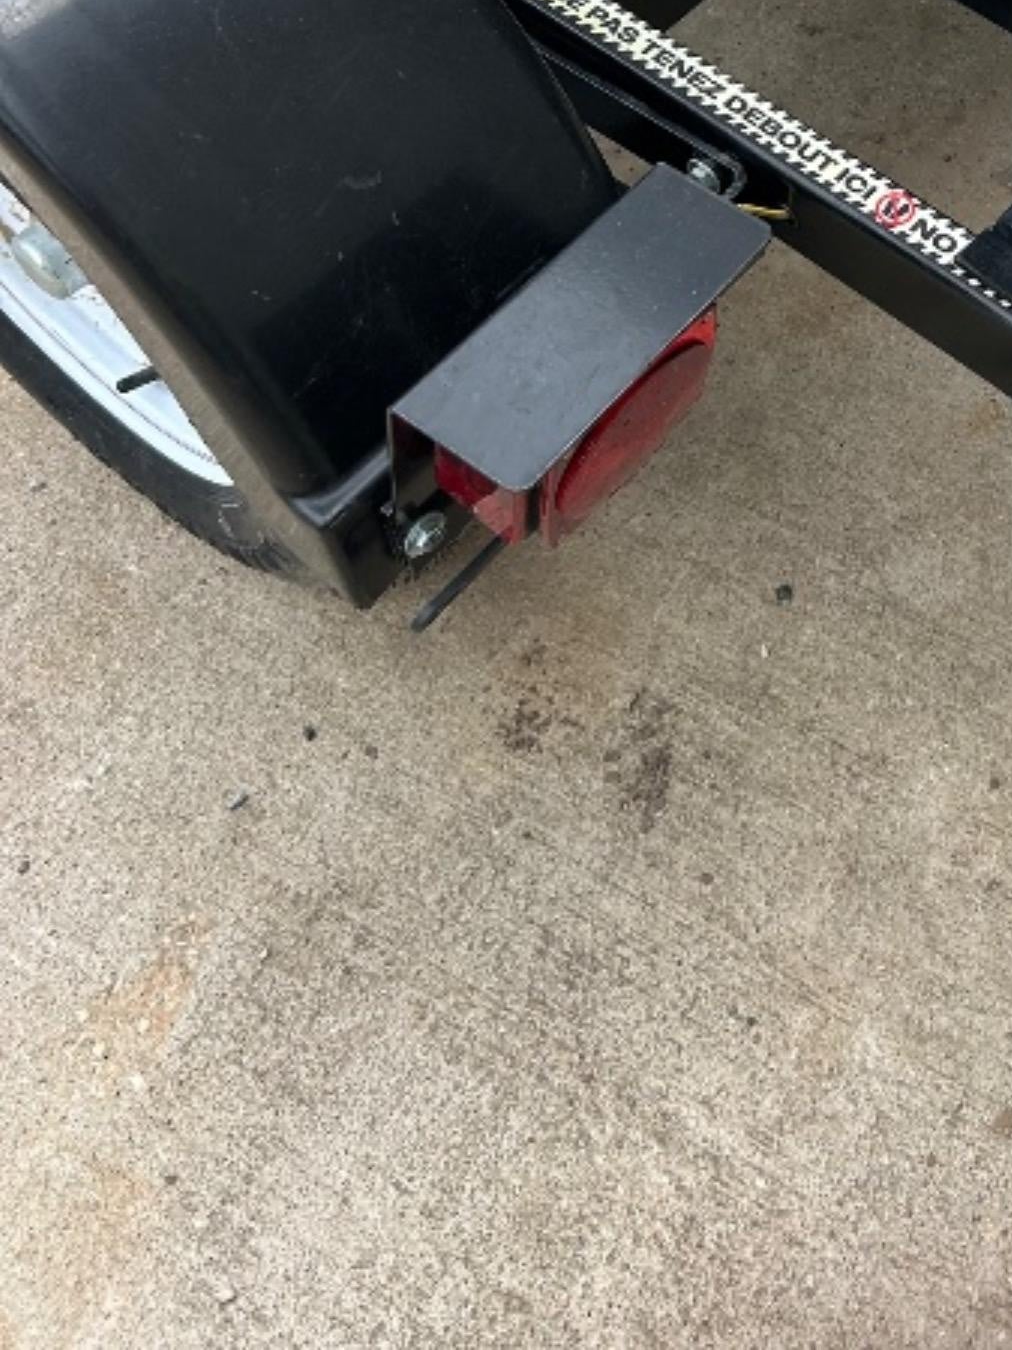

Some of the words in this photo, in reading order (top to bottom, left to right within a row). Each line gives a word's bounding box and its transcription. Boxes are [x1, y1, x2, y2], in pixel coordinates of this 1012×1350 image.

[587, 6, 640, 44] PAS
[640, 40, 727, 99] TENEZ
[723, 94, 839, 172] DEBOUT
[834, 167, 877, 199] ICI
[910, 217, 958, 254] NO
